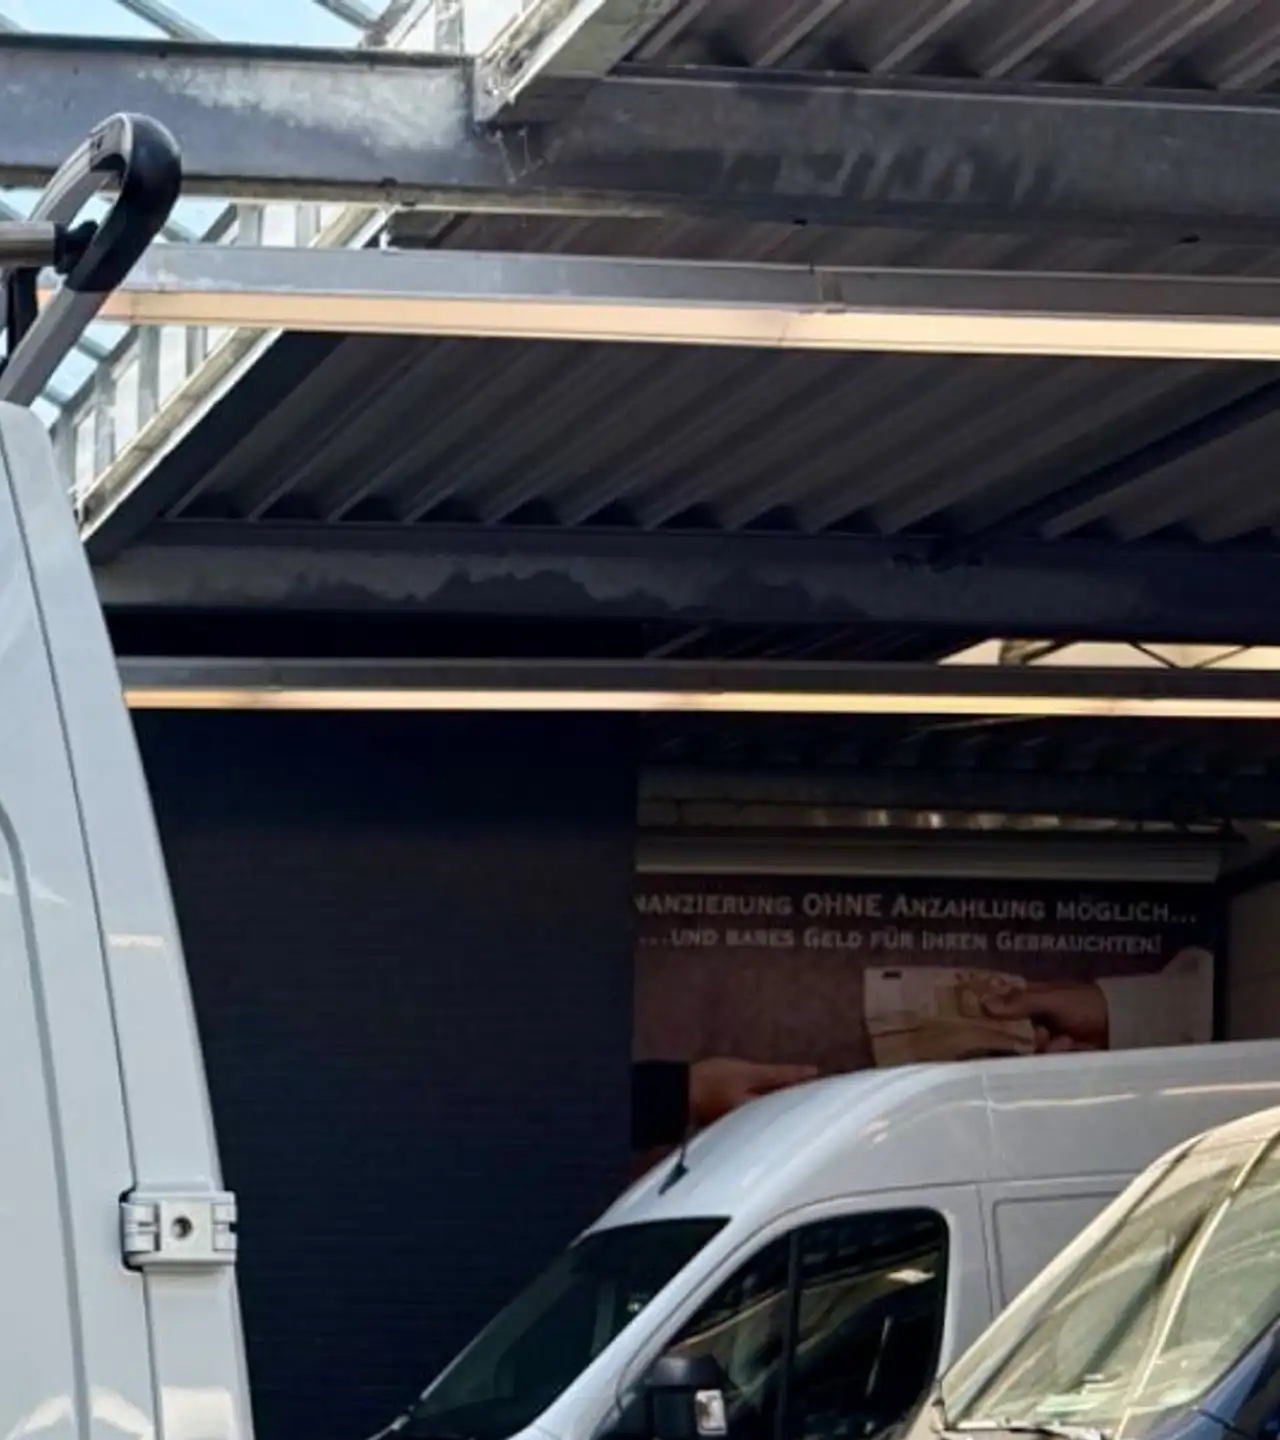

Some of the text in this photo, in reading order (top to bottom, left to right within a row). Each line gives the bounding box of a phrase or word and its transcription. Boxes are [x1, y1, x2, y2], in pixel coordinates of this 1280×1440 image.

[803, 892, 882, 918] OHNE
[890, 893, 1046, 922] ANZAHLUNG
[802, 924, 864, 950] GELD
[870, 924, 914, 950] FÜR
